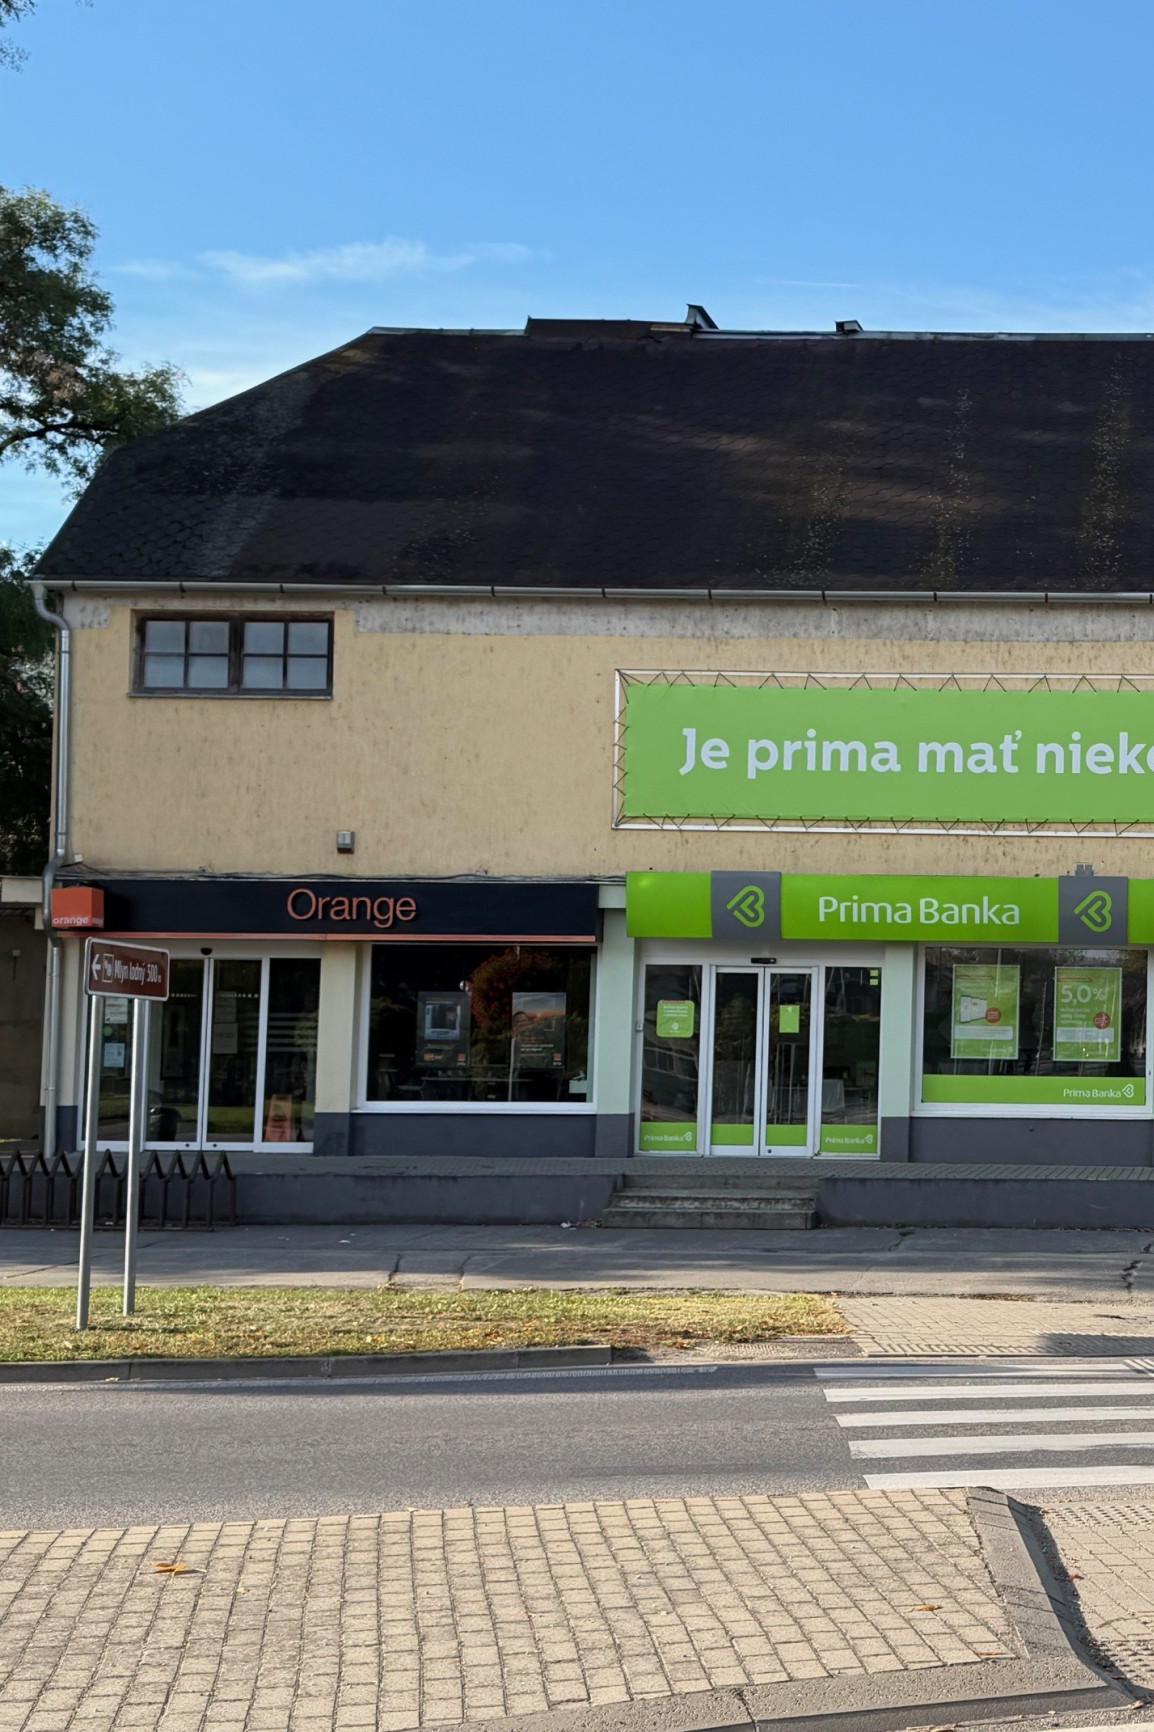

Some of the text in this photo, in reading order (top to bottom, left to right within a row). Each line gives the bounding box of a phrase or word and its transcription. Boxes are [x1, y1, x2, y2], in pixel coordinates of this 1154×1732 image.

[679, 727, 730, 776] Je
[747, 728, 901, 779] prima
[918, 729, 1022, 774] mať
[52, 916, 89, 926] orange
[286, 888, 417, 928] Orange
[818, 895, 1020, 925] Prima Banka
[1063, 1088, 1122, 1098] Prima Banka
